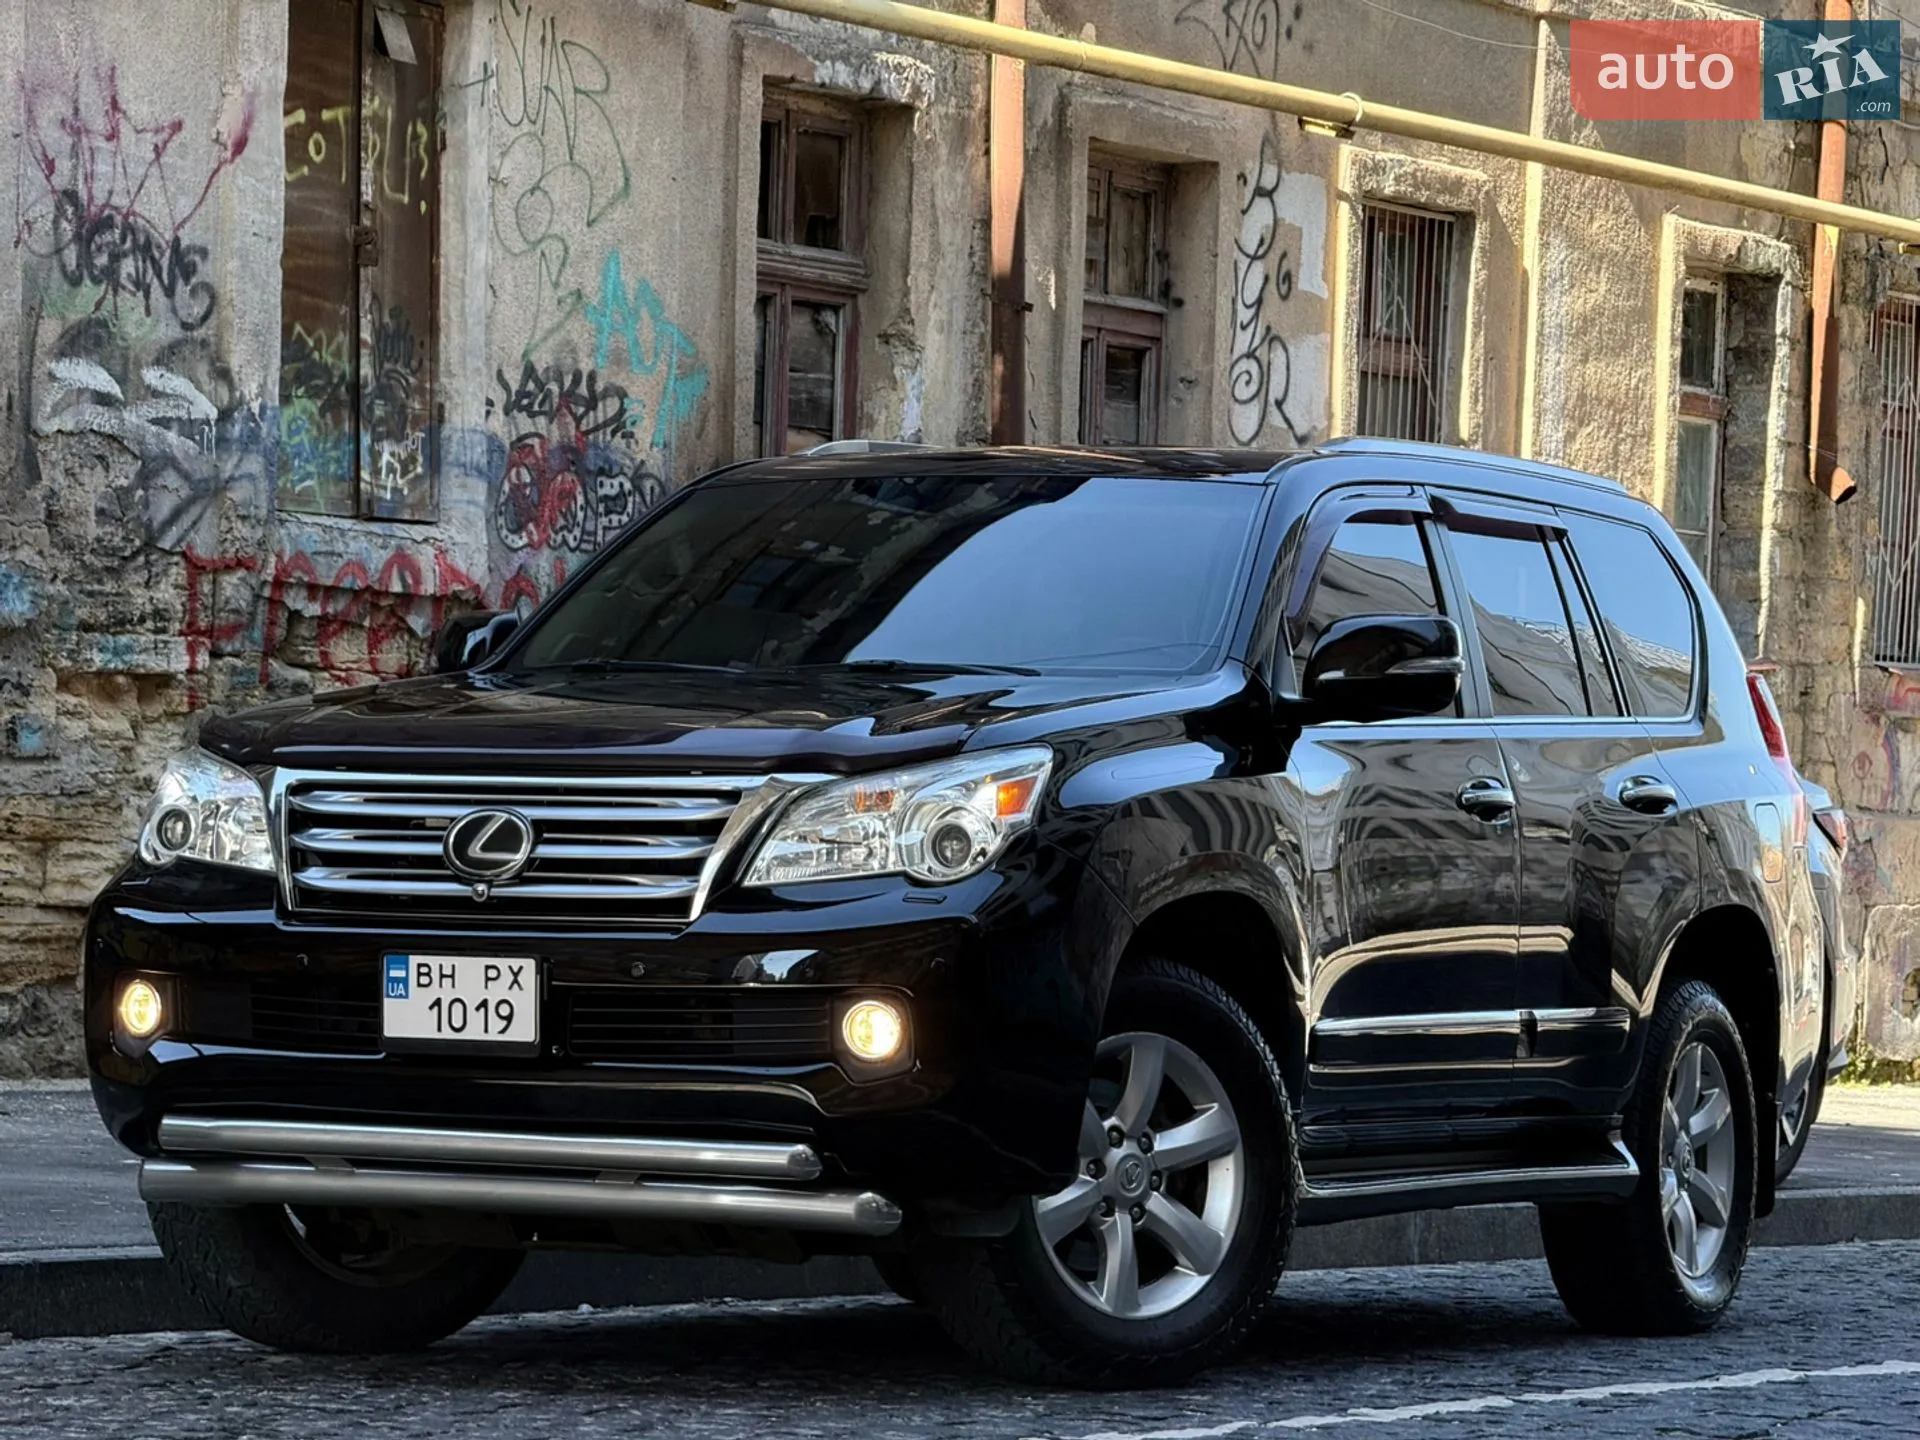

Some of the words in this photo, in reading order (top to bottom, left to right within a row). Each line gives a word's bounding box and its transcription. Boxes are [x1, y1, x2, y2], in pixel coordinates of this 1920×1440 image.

[388, 982, 406, 997] UA
[416, 962, 456, 989] BH
[484, 964, 524, 992] PX
[428, 996, 515, 1035] 1019
